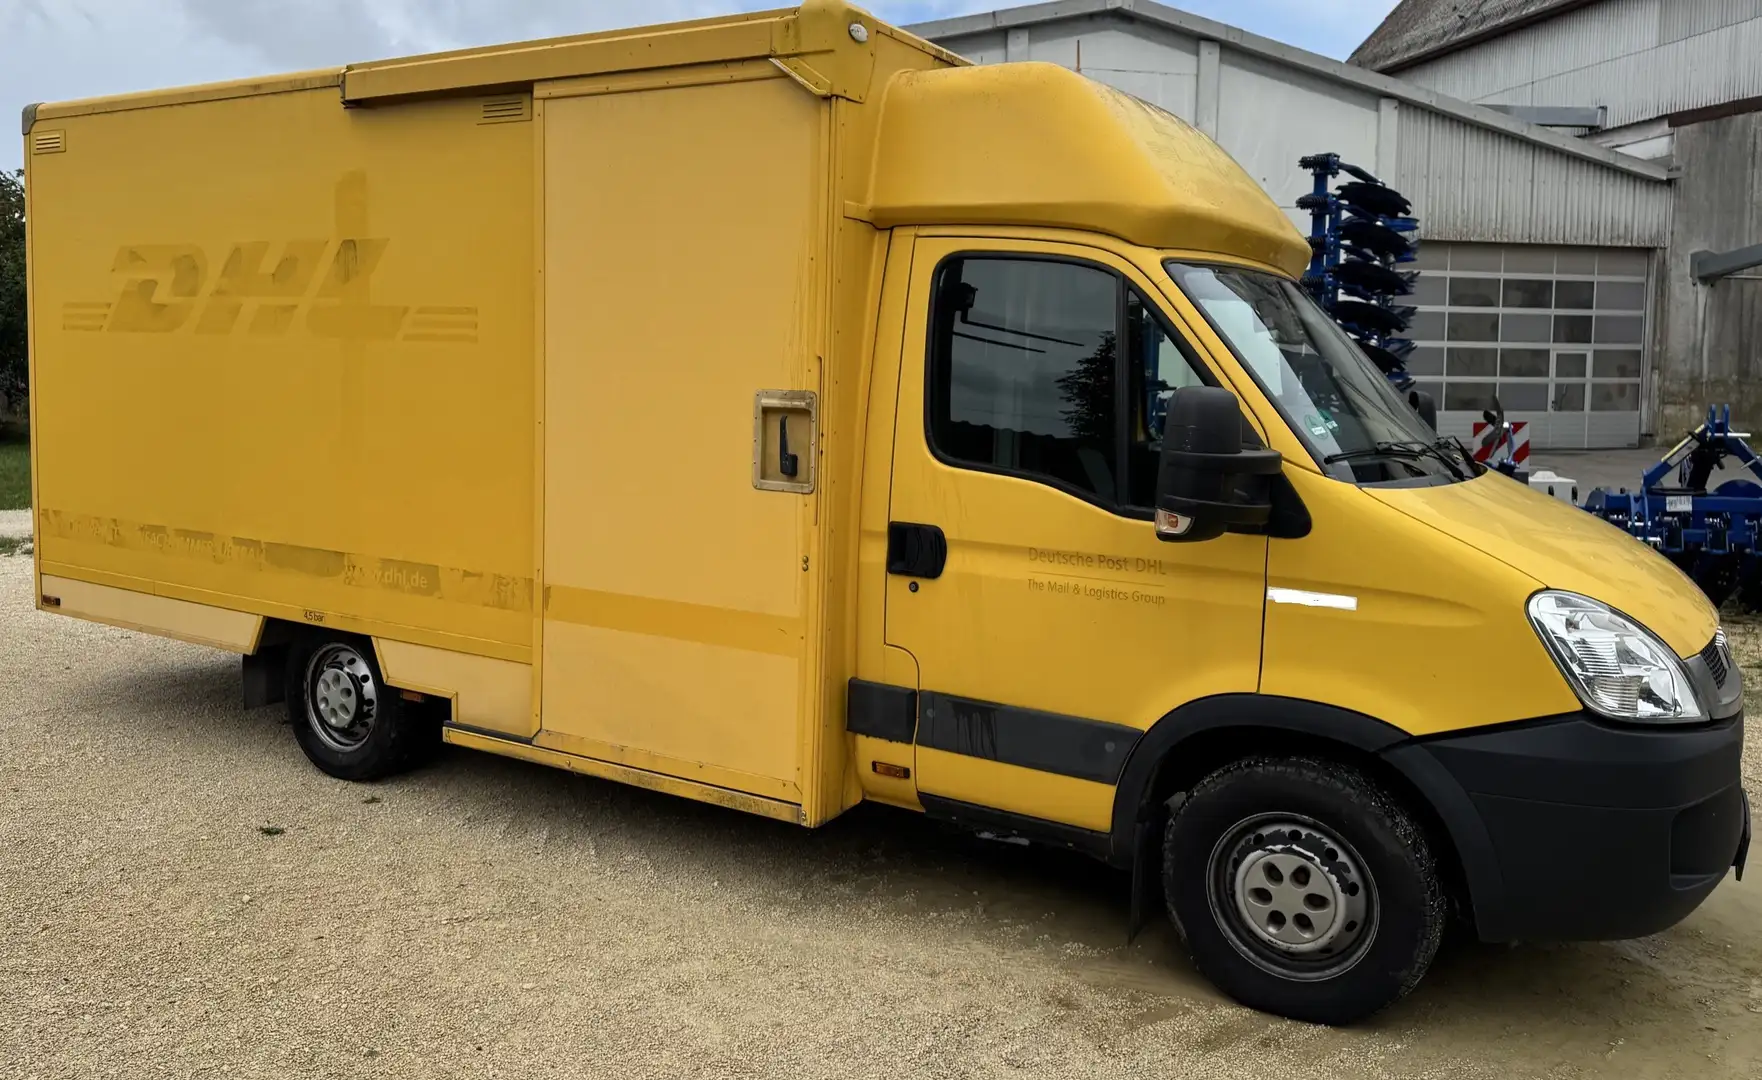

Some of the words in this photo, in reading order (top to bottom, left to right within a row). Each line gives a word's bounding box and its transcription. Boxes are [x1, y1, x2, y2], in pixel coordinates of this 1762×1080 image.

[107, 237, 409, 339] DHL
[1028, 547, 1094, 568] Deutsche
[1097, 554, 1129, 571] Post
[1135, 557, 1166, 575] DHL
[1028, 578, 1045, 591] The
[1047, 581, 1069, 594] Mail
[1073, 583, 1081, 595] &
[1084, 584, 1129, 601] Logistics
[1132, 591, 1166, 608] Group
[313, 611, 325, 623] bar
